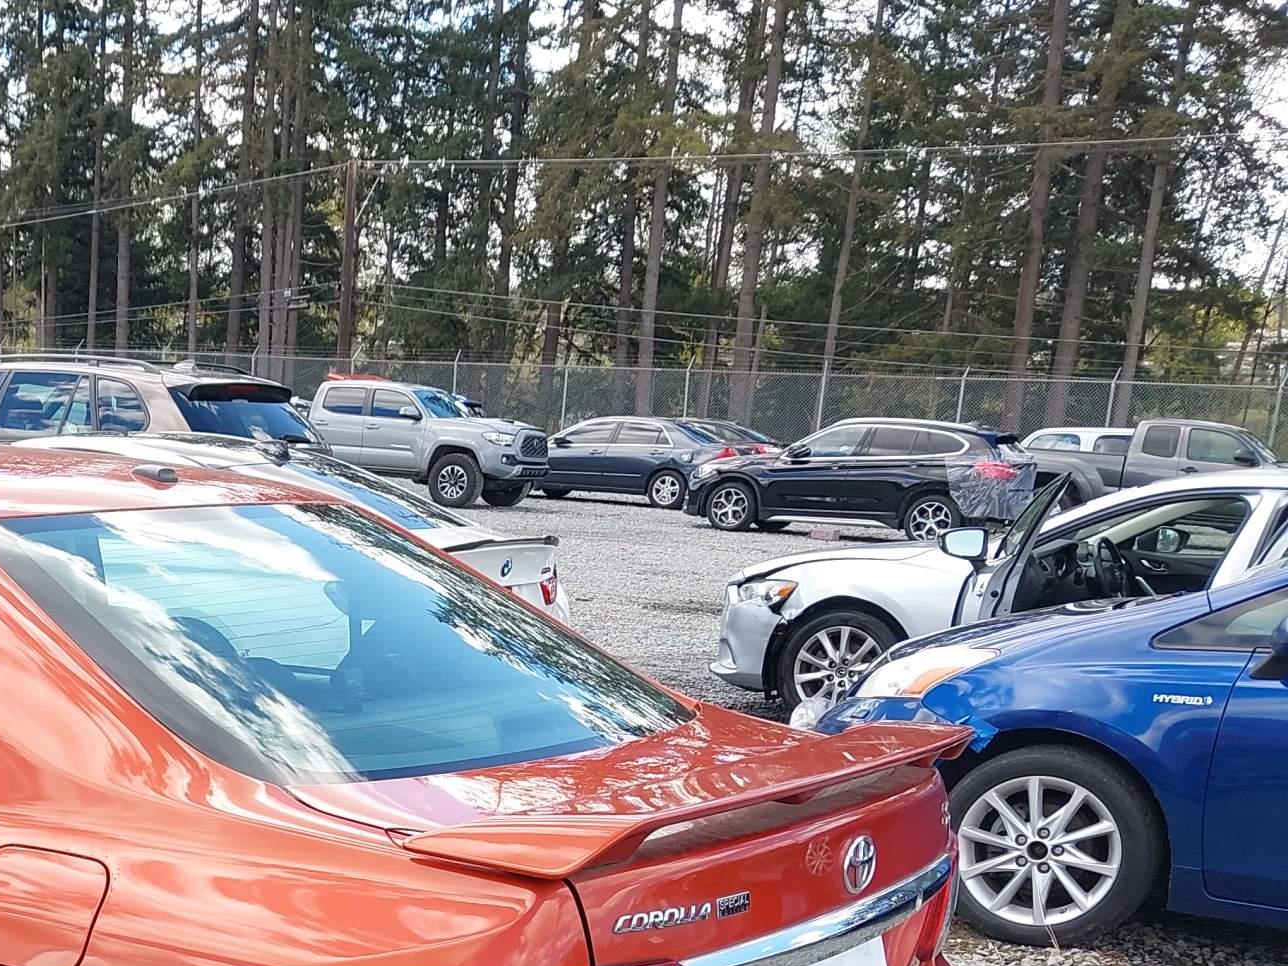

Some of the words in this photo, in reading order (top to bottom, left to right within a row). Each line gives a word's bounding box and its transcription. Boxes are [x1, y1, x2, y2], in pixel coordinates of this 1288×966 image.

[1153, 693, 1205, 706] HYBRID
[614, 902, 711, 933] COROLLA
[719, 892, 749, 911] SPECIAL
